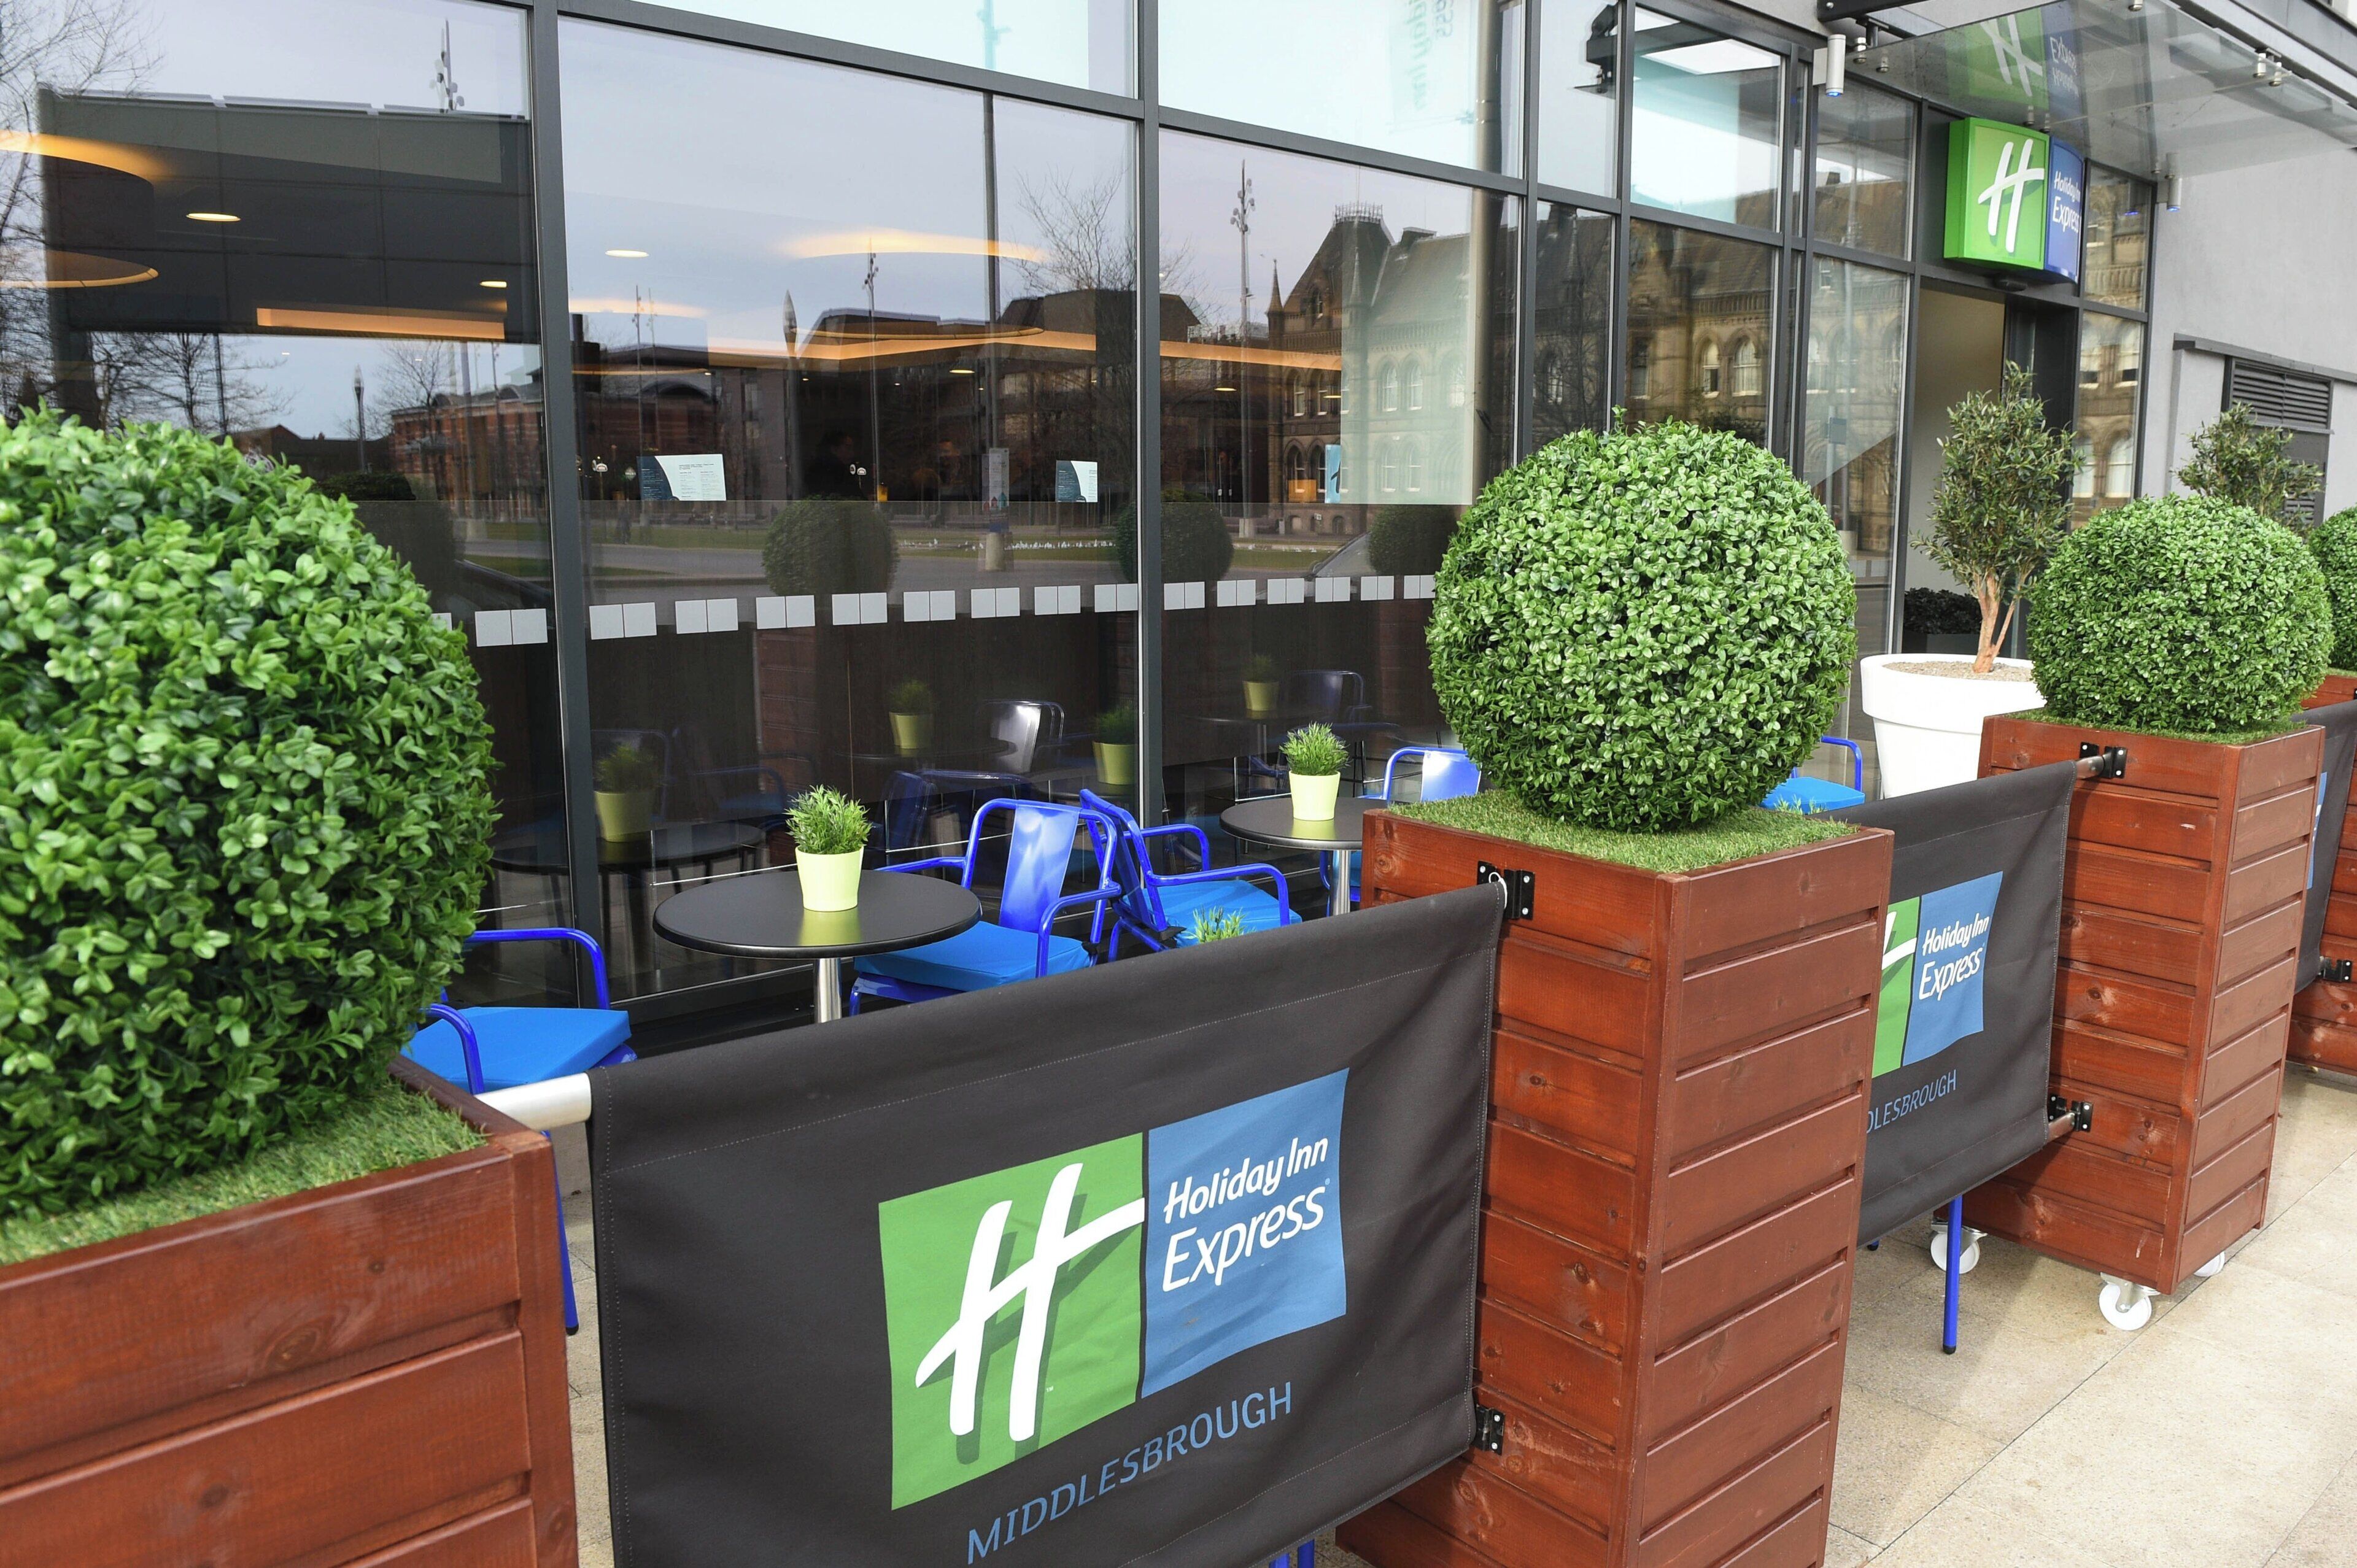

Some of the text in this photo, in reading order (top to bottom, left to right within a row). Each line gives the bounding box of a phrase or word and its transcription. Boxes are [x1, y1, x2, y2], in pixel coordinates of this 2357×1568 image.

[2054, 171, 2076, 203] Holiday
[2053, 195, 2079, 233] Express
[1922, 921, 1972, 956] Holiday
[1972, 913, 1989, 938] Inn
[1919, 948, 1983, 1000] Express
[1164, 1138, 1328, 1223] Holiday Inn
[1163, 1187, 1325, 1291] Express
[967, 1382, 1291, 1564] MIDDLESBROUGH
